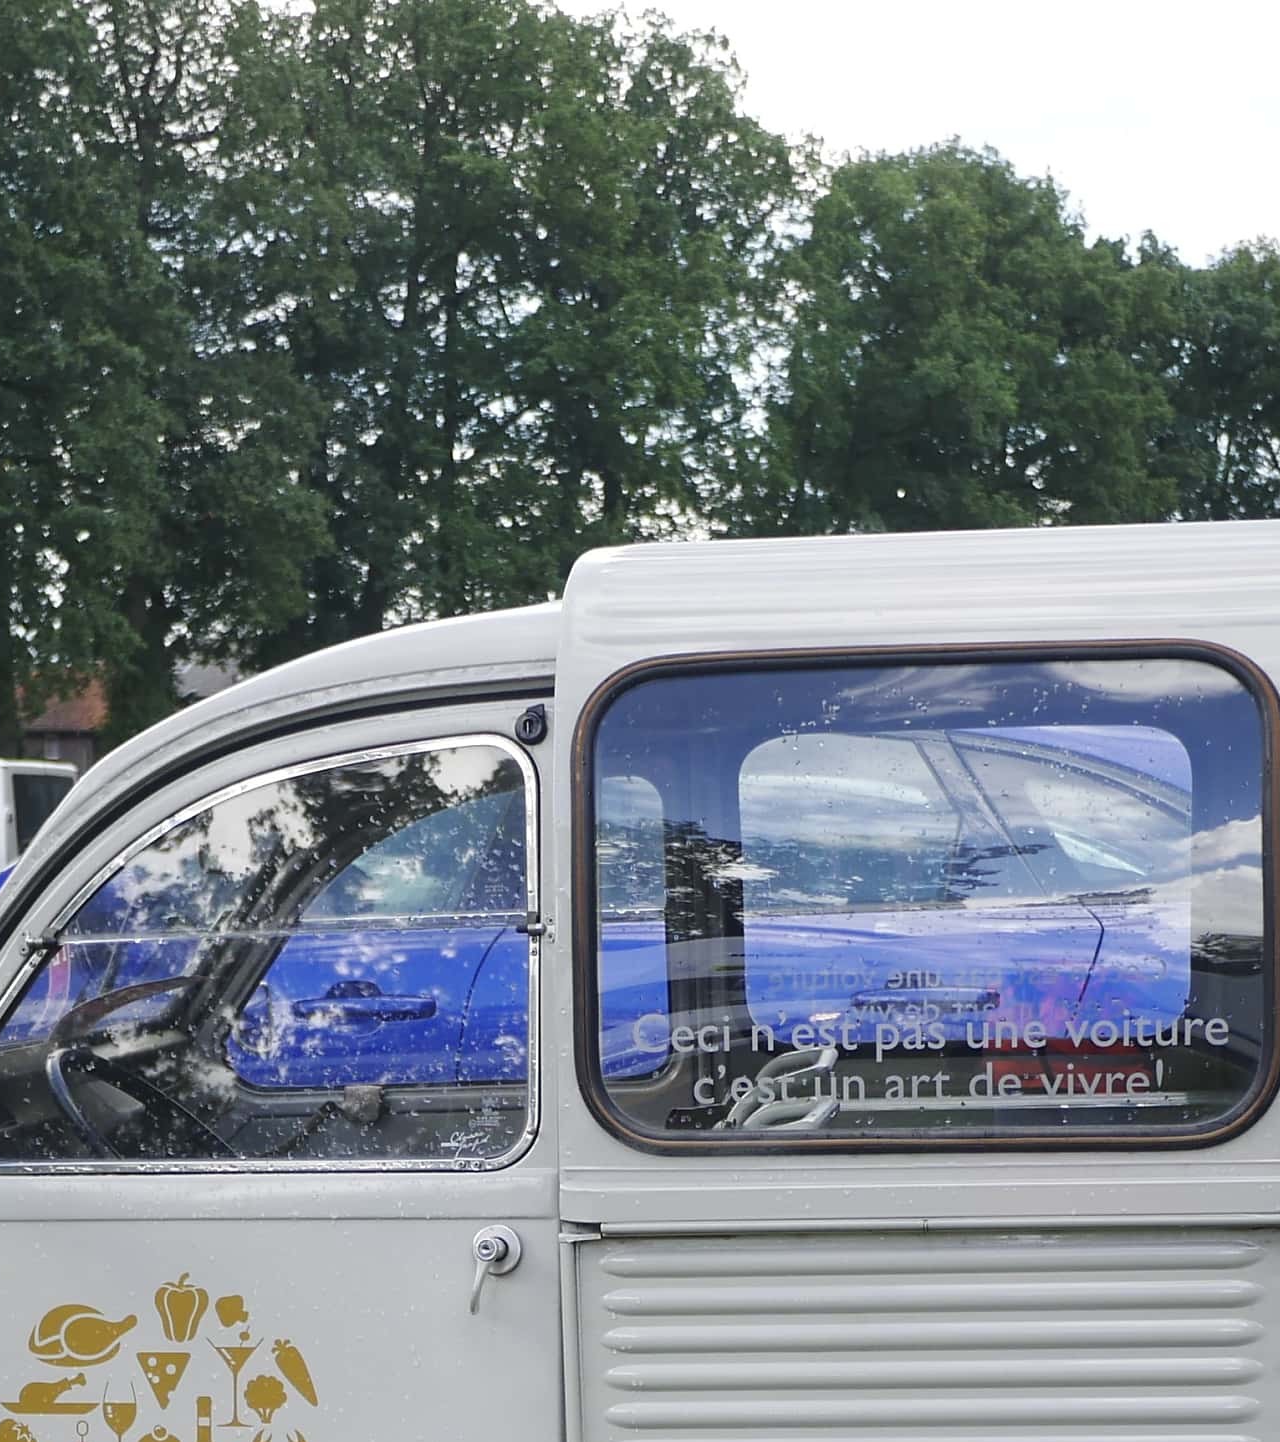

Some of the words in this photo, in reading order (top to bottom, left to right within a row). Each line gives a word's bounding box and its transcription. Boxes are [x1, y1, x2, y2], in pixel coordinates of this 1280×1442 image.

[632, 1012, 731, 1054] Ceci
[751, 1009, 858, 1053] n'est
[875, 1020, 946, 1063] pas
[966, 1019, 1048, 1050] une
[1064, 1008, 1230, 1049] voiture
[693, 1063, 795, 1105] c'est
[814, 1074, 866, 1103] un
[884, 1070, 951, 1102] art
[969, 1060, 1023, 1100] de
[1040, 1057, 1164, 1100] vivre!
